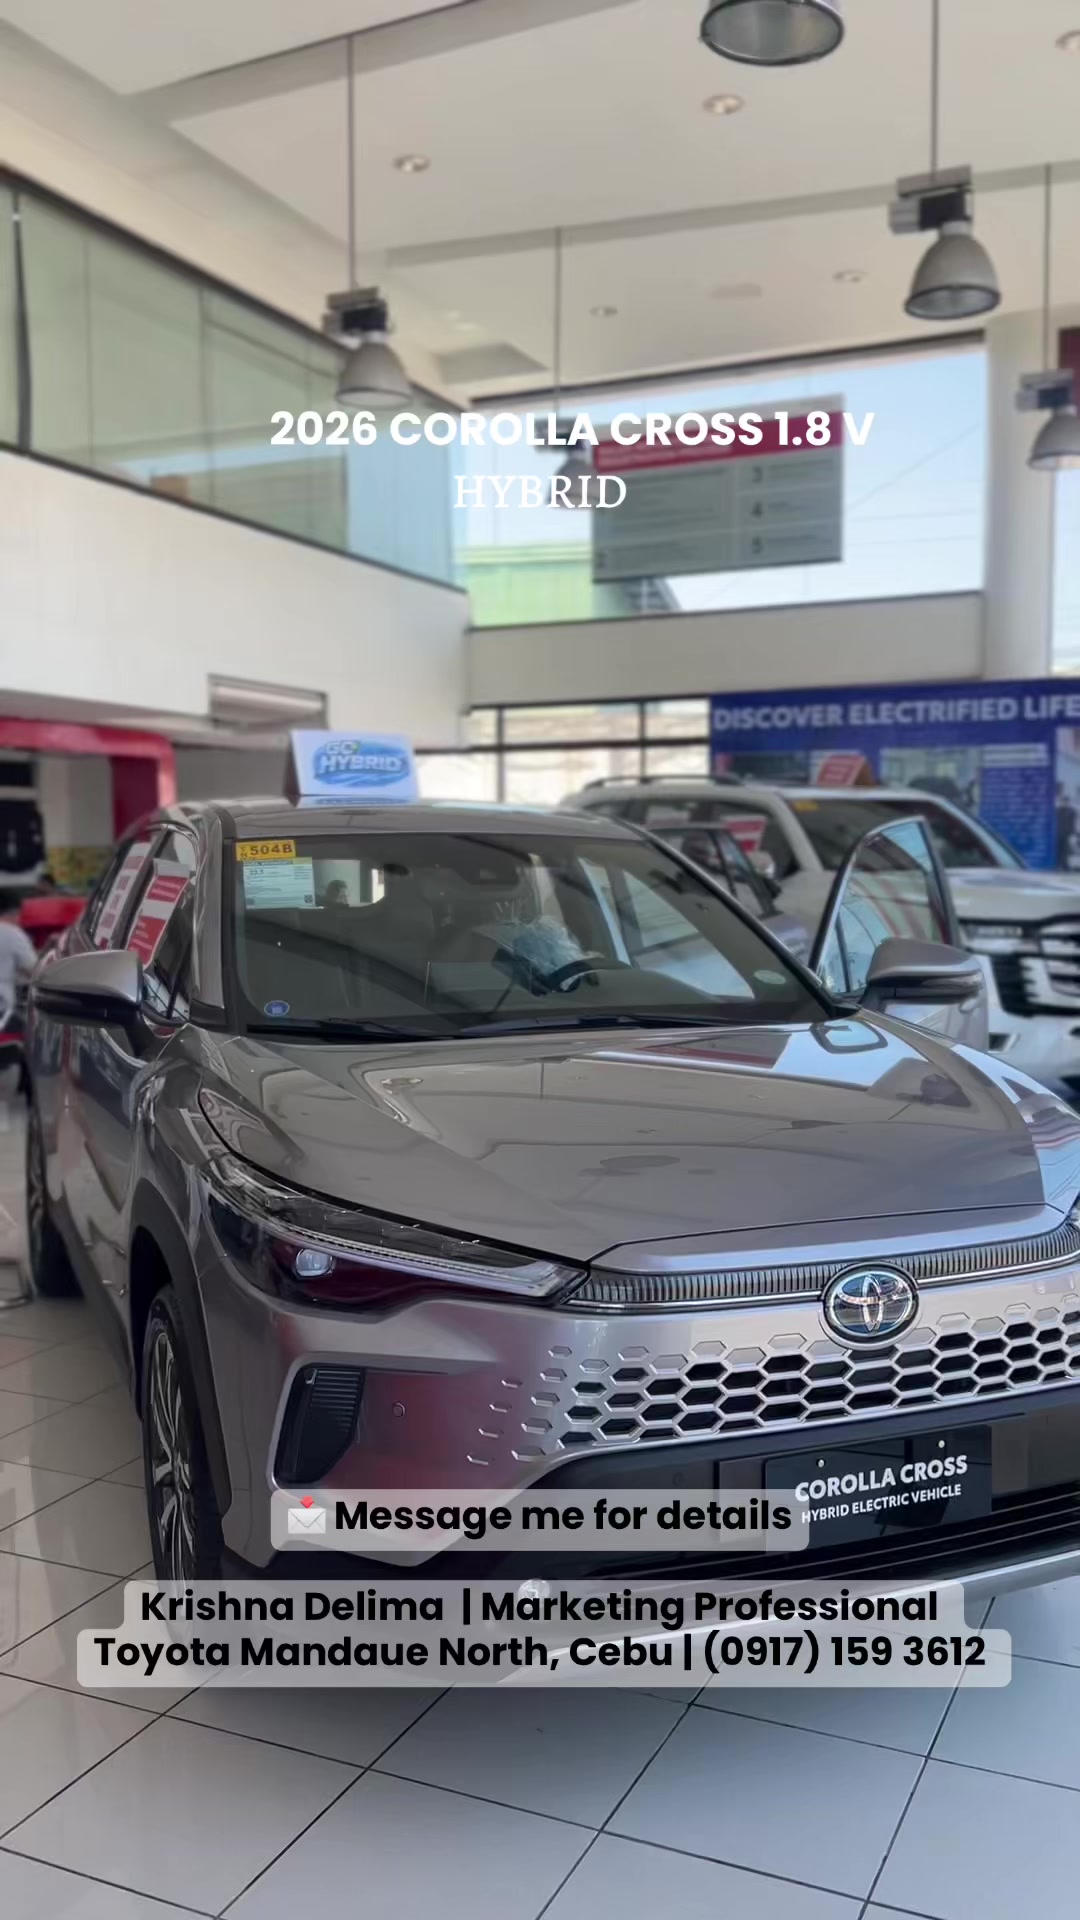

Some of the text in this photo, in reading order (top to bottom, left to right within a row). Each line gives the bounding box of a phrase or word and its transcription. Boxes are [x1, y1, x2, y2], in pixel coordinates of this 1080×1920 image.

[713, 704, 843, 731] DISCOVER
[851, 698, 1019, 726] ELECTRIFIED
[326, 740, 360, 755] GO
[319, 755, 402, 774] HYBRID
[795, 1454, 968, 1502] COROLLA CROSS
[801, 1483, 962, 1525] HYBRID ELECTRIC VEHICLE
